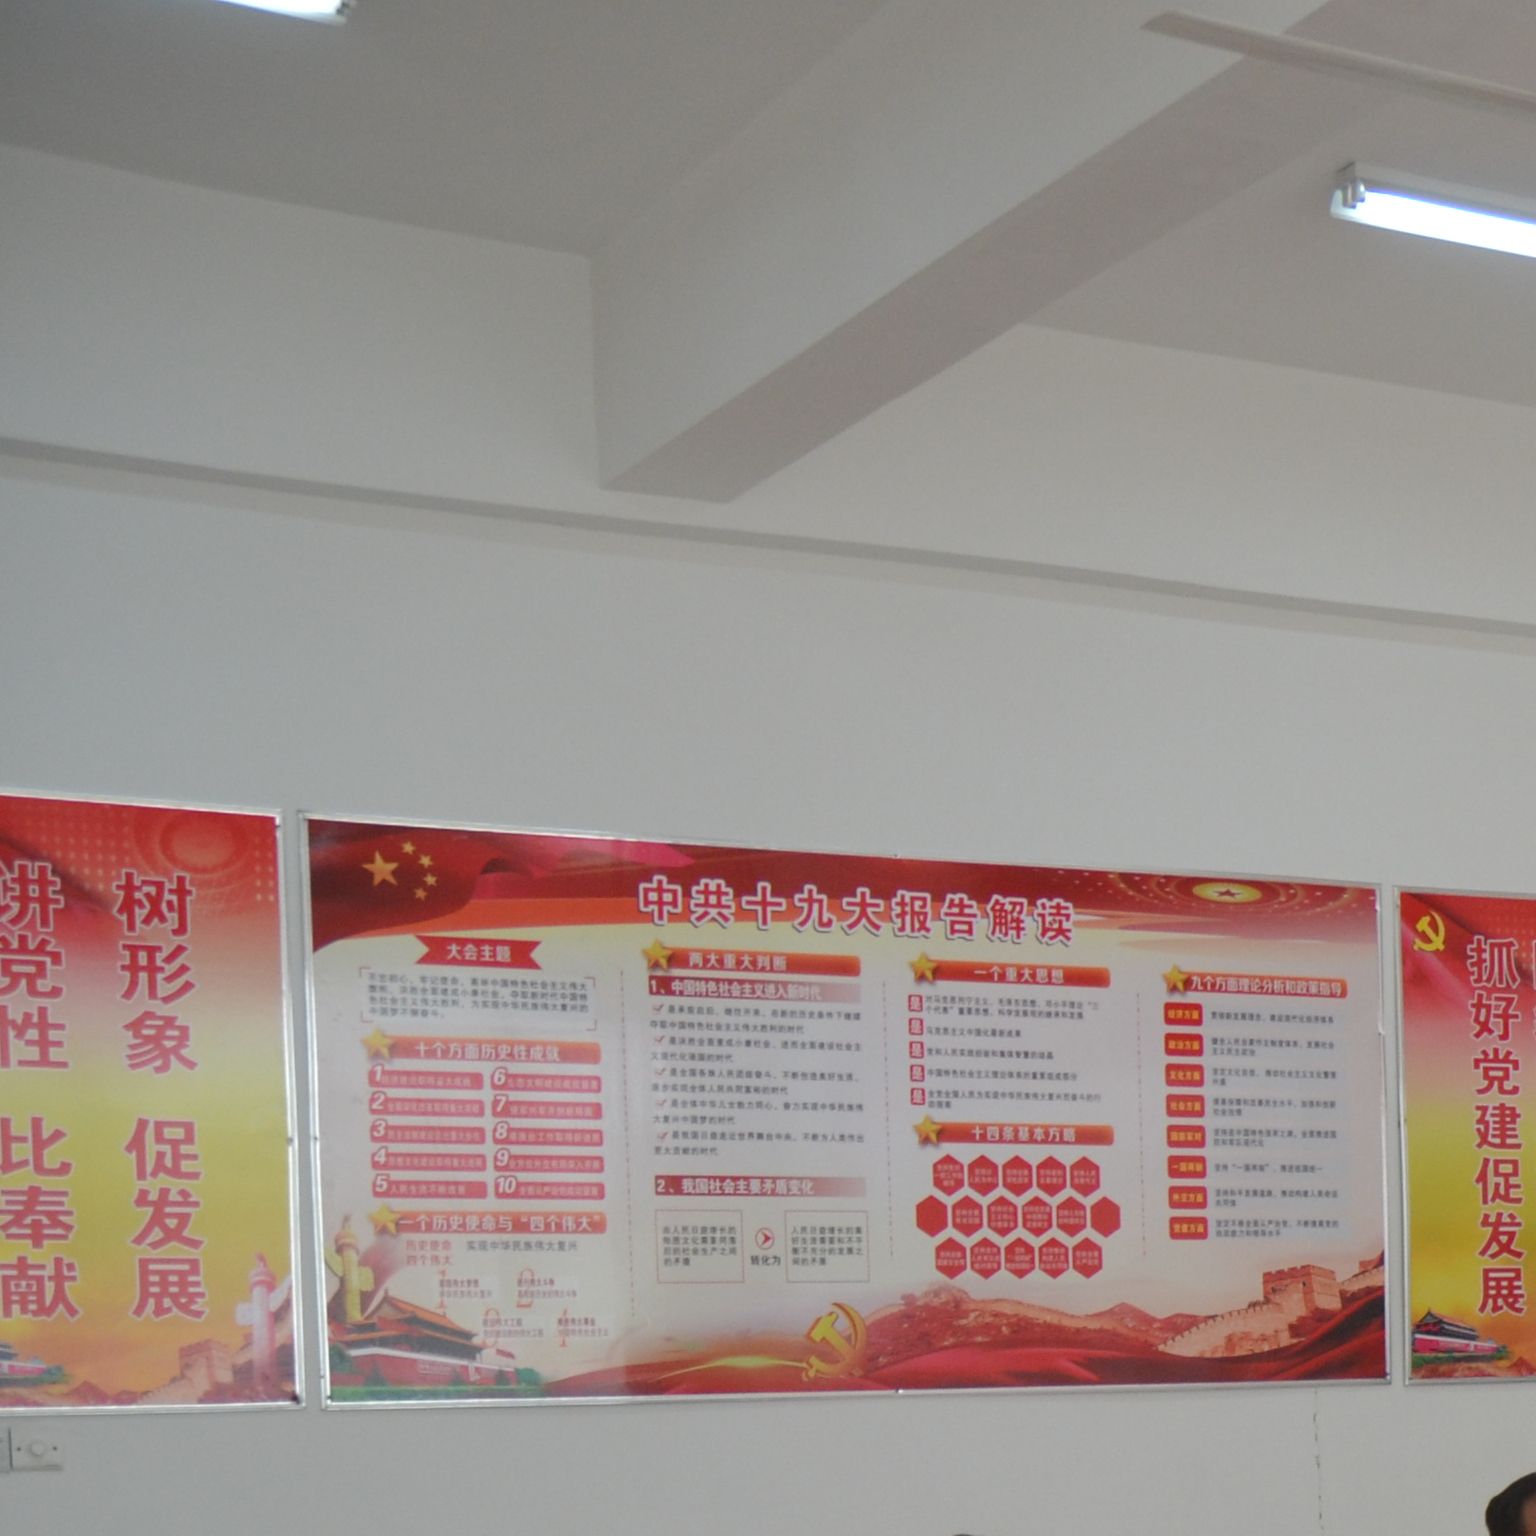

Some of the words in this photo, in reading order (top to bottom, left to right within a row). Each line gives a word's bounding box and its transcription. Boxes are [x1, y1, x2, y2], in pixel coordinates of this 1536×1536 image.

[637, 873, 1076, 947] 中共十九大报告解读
[446, 943, 512, 964] 大会主题
[688, 951, 788, 972] 两大重大判断
[113, 868, 199, 1075] 树形象
[974, 965, 1066, 985] 一个重大思想
[650, 979, 823, 1000] 1、中国特色社会主义进入新时代
[416, 1041, 561, 1063] 十个方面历史性成就
[373, 1066, 382, 1081] 1
[493, 1069, 506, 1084] 6
[372, 1094, 384, 1110] 2
[495, 1097, 507, 1112] 7
[373, 1121, 385, 1137] 3
[496, 1124, 508, 1139] 8
[971, 1125, 1076, 1143] 十四条基本方略
[1467, 936, 1529, 1318] 抓好党建促发展
[374, 1150, 386, 1165] 4
[497, 1151, 509, 1166] 9
[375, 1177, 388, 1192] 5
[499, 1177, 516, 1193] 10
[656, 1178, 815, 1196] 2、我国社会主要矛盾变化
[0, 1114, 81, 1323] 比奉献
[124, 1116, 209, 1322] 促发展
[400, 1214, 599, 1233] 一个历史使命与“四个伟大”
[750, 1255, 782, 1267] 转化为
